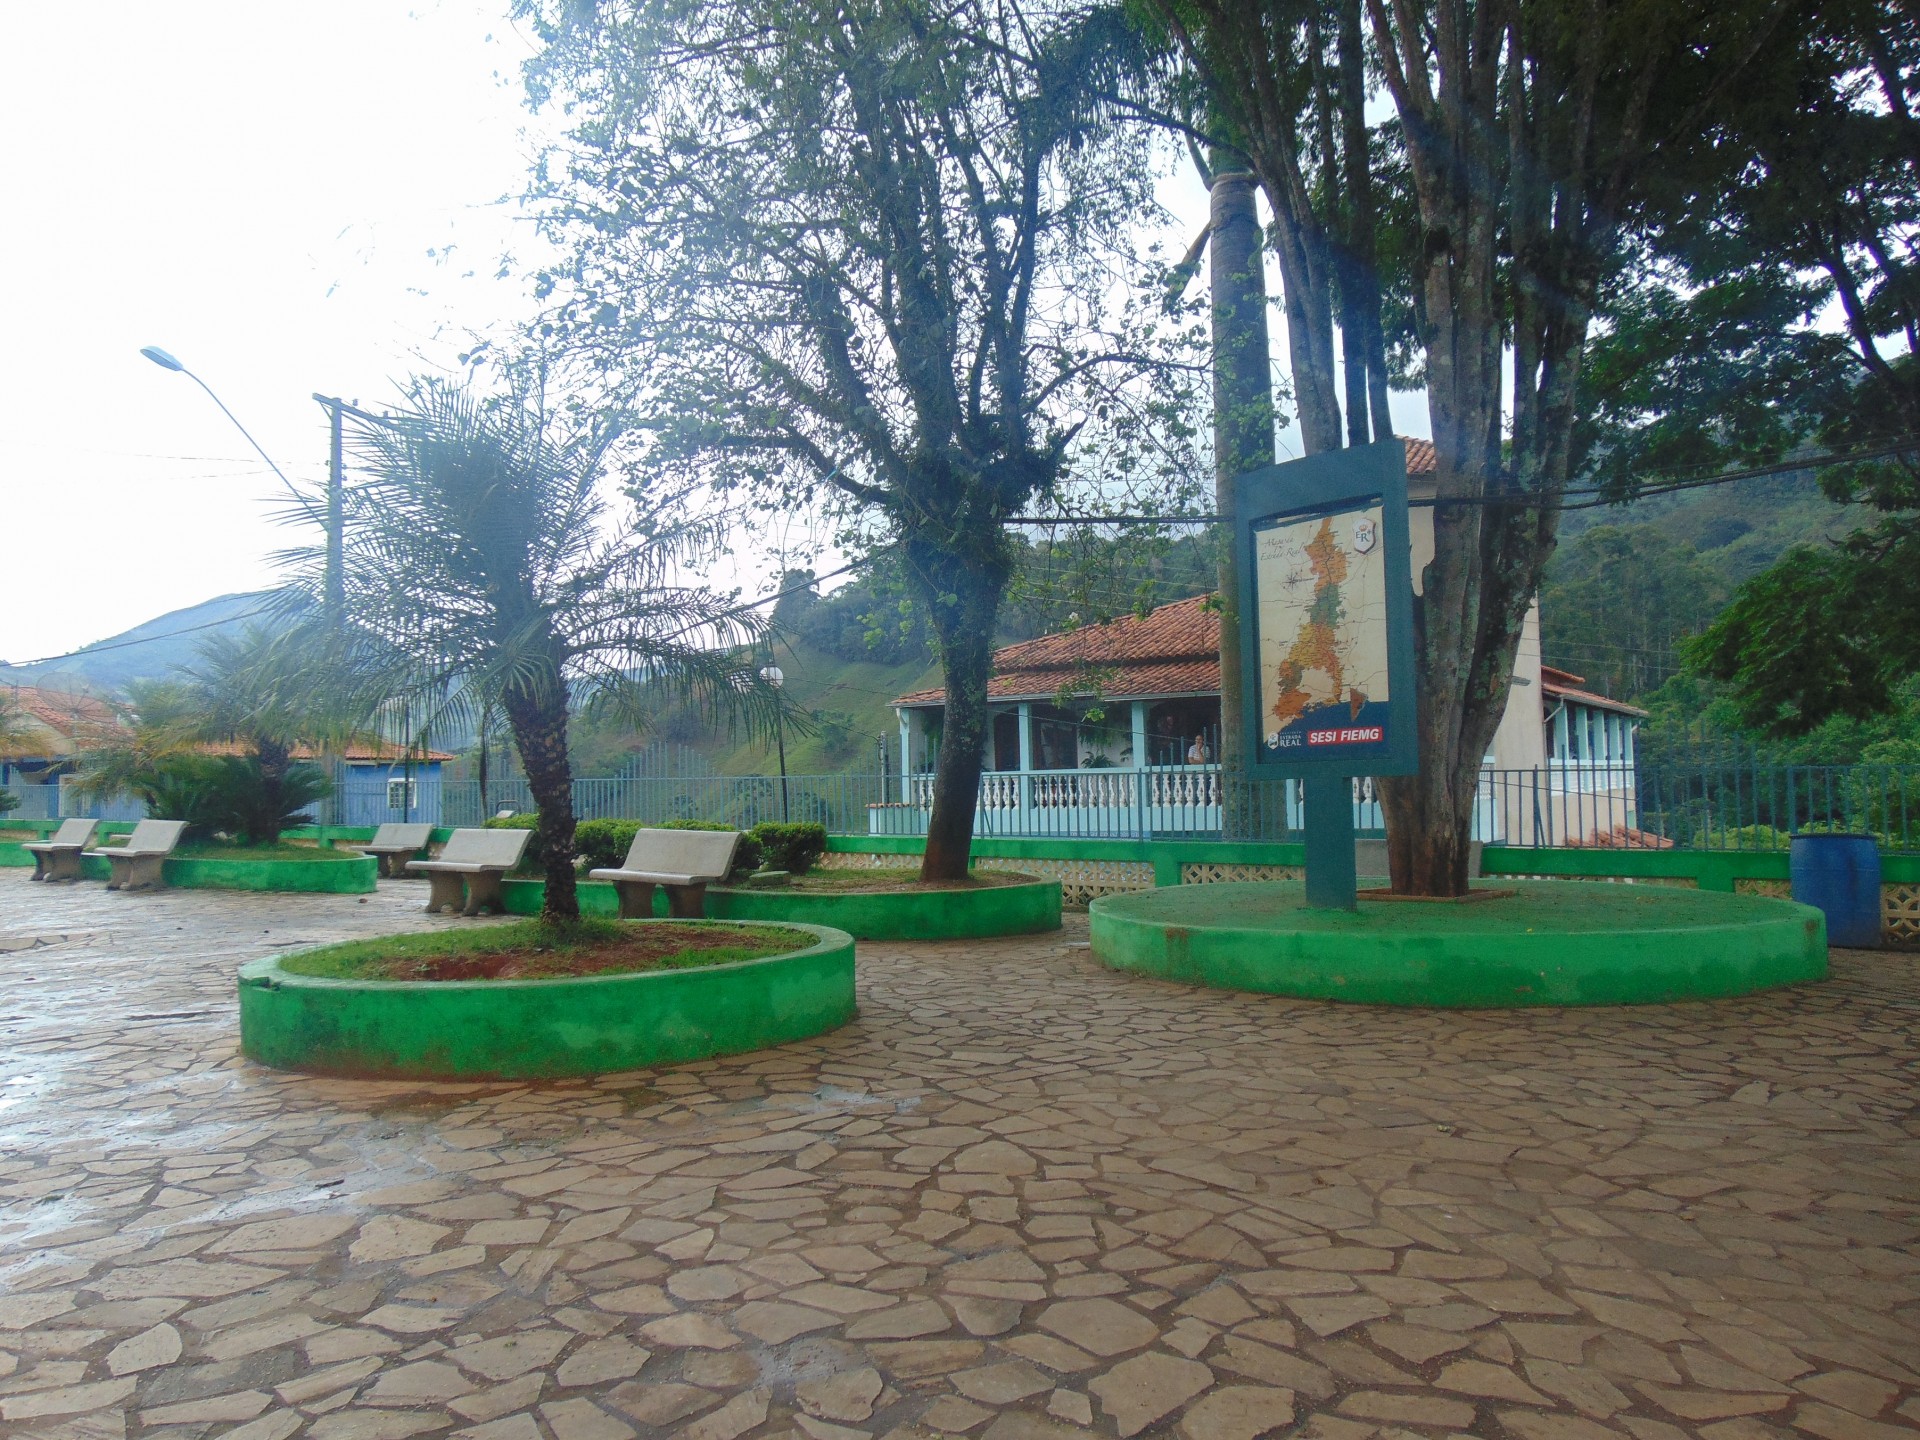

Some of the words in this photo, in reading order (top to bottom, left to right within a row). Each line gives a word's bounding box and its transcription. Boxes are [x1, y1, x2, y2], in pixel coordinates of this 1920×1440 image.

[1310, 731, 1336, 743] SESI
[1340, 728, 1379, 741] FIEMG
[1279, 739, 1302, 748] REAL
